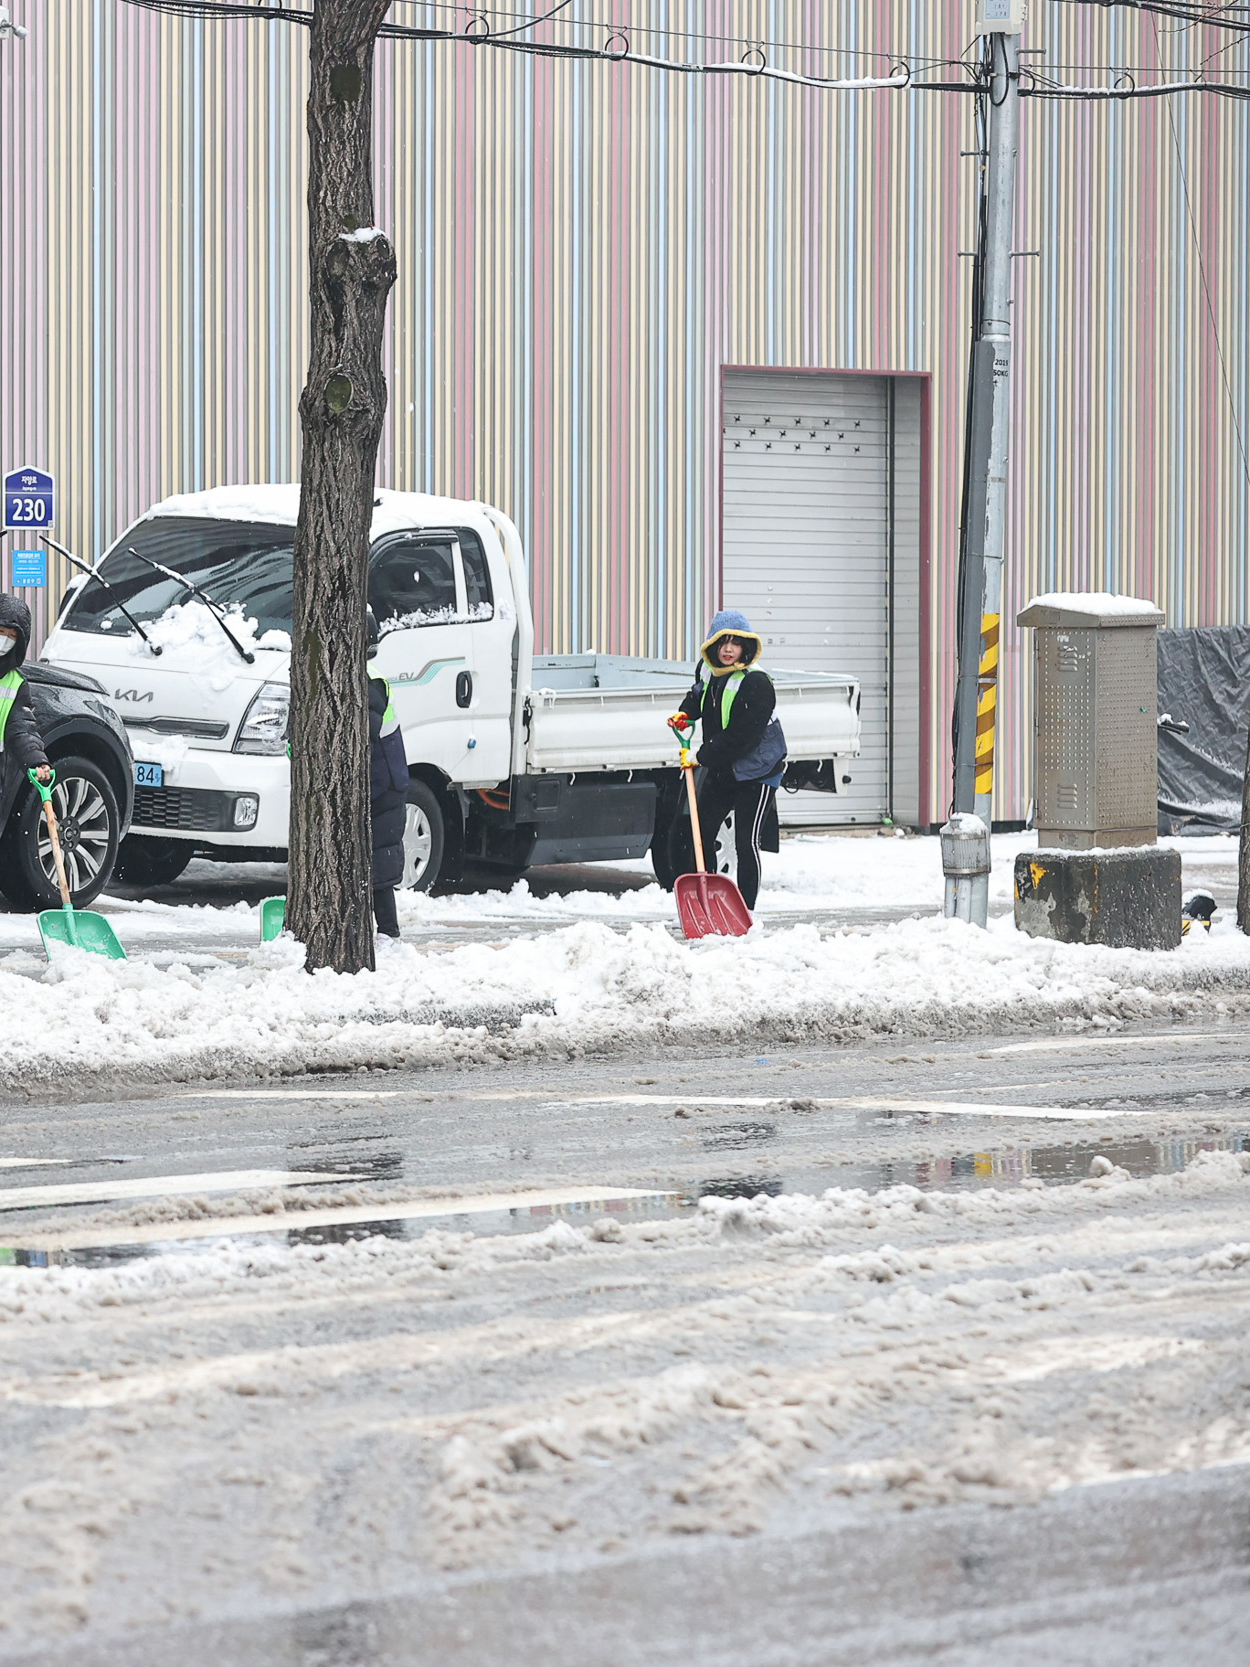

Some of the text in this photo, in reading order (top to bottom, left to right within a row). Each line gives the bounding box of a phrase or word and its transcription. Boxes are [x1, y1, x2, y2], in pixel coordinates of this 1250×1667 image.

[12, 498, 46, 522] 230
[399, 672, 414, 681] EV
[114, 688, 154, 703] KIA
[137, 765, 155, 784] 84
